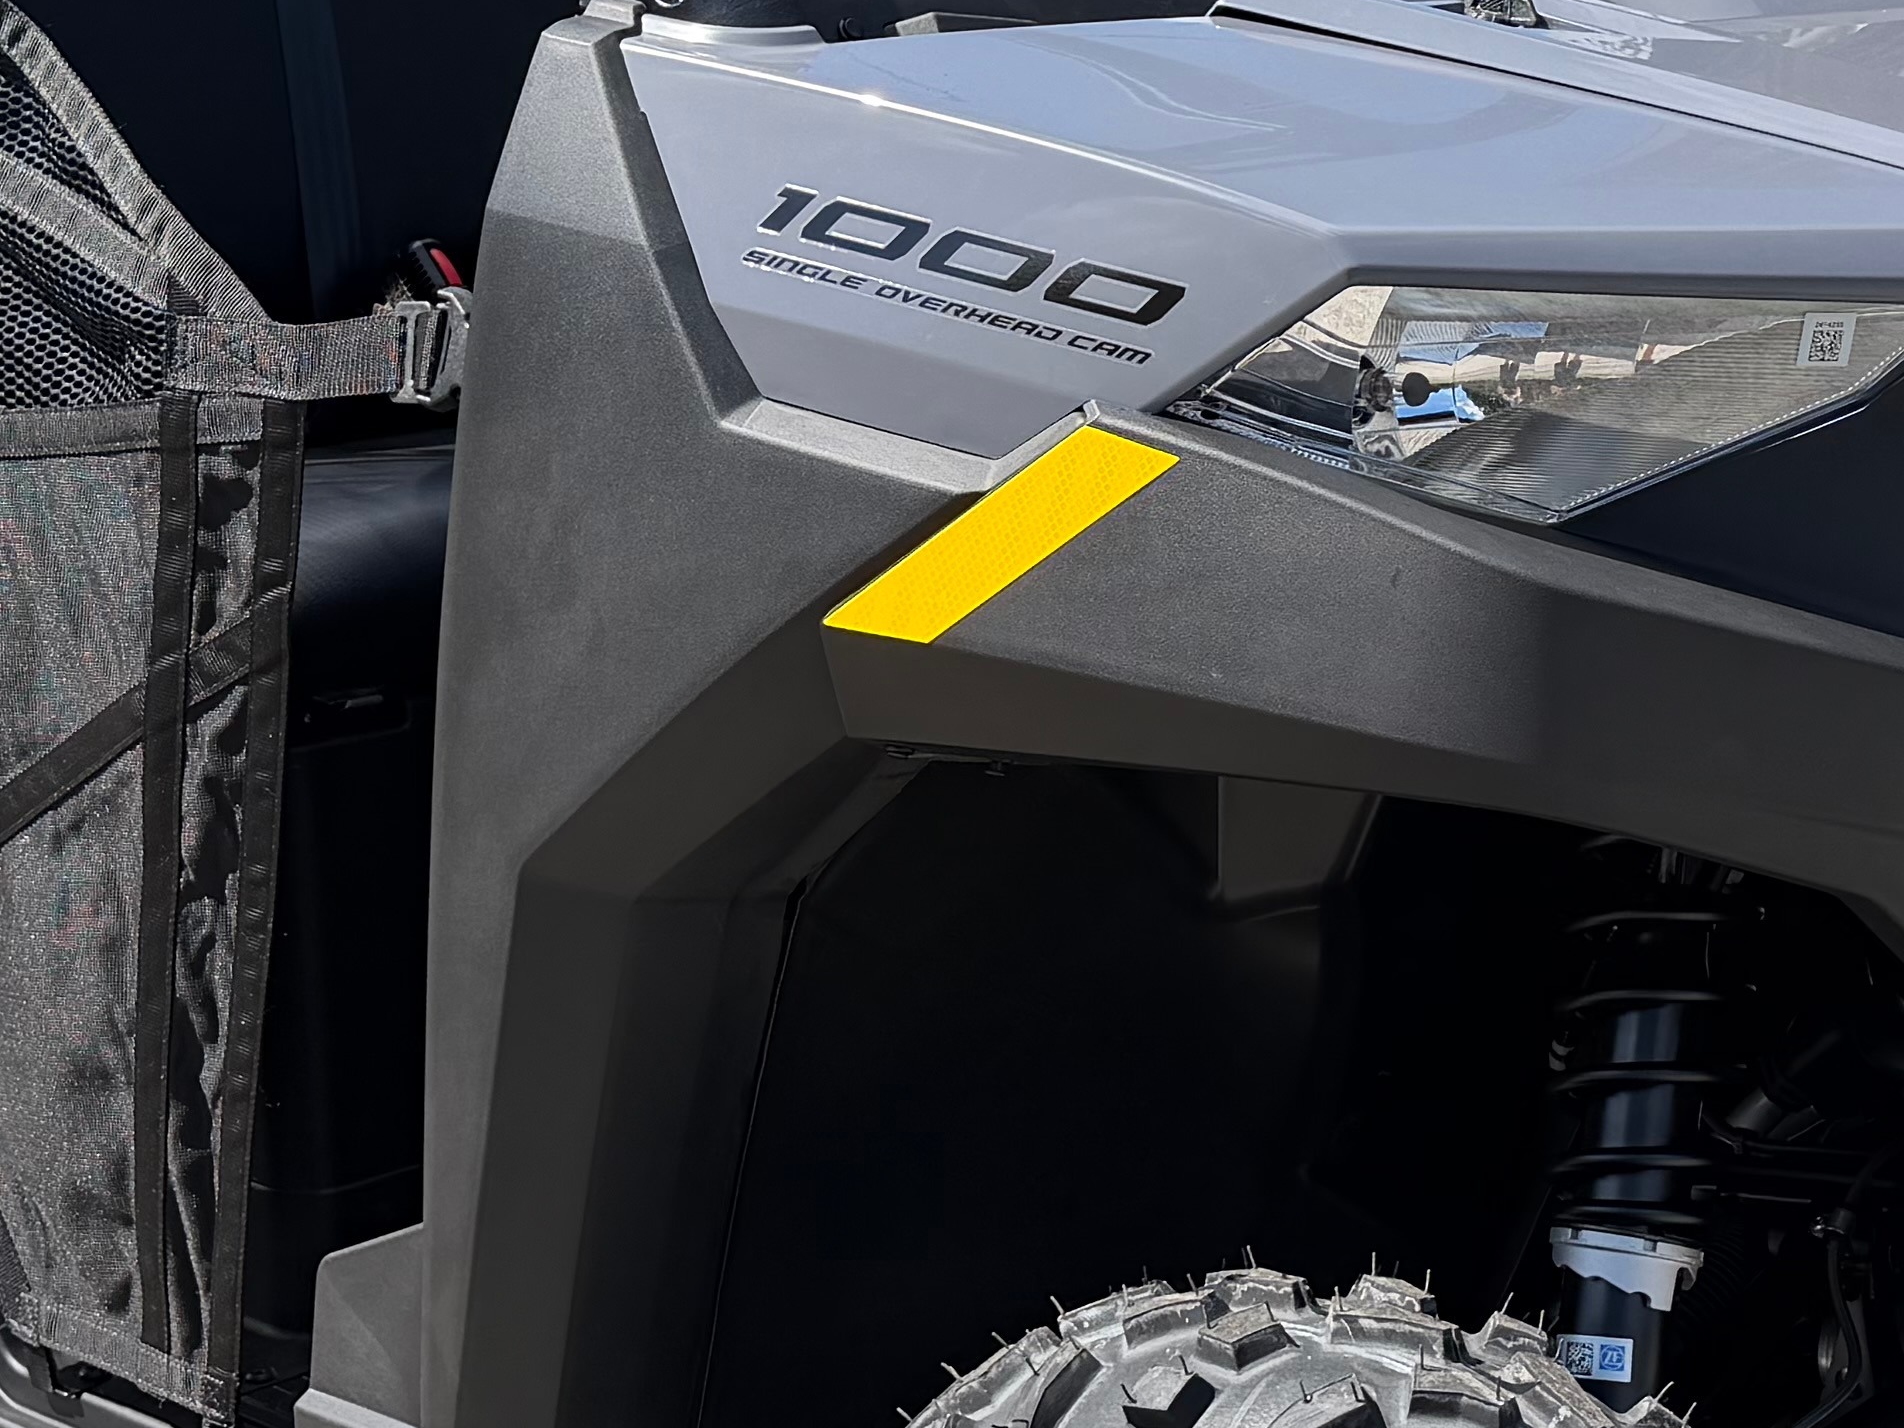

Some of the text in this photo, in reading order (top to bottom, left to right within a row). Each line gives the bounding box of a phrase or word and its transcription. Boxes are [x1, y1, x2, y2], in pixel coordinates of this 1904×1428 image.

[743, 247, 1154, 368] SINGLE OVERHEAD CAM
[756, 183, 1190, 328] 1000
